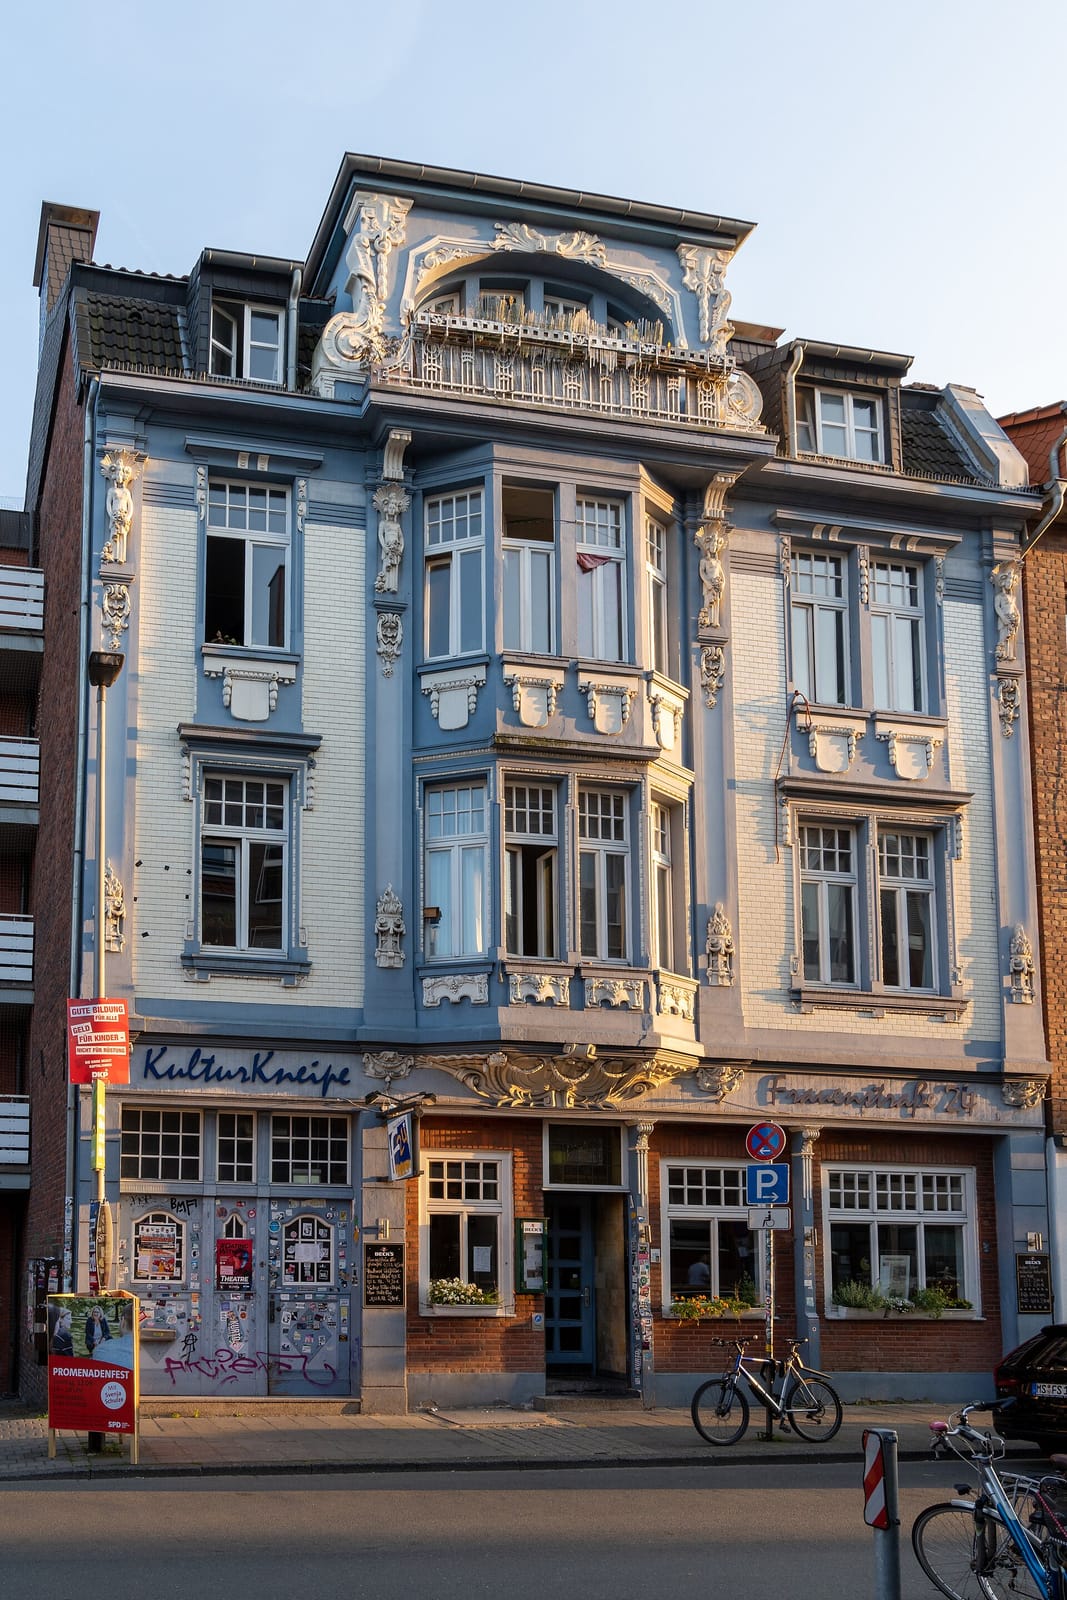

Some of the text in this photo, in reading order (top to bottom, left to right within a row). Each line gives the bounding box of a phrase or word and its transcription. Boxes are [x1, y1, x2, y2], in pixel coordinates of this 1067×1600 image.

[71, 1005, 124, 1016] GUTE BILDUNG
[72, 1025, 91, 1034] GELD
[79, 1034, 93, 1043] FÜR
[94, 1034, 119, 1042] KINDER
[91, 1070, 109, 1078] DKP
[143, 1046, 351, 1097] KulturKneipe
[944, 1083, 977, 1117] 24
[756, 1169, 779, 1199] P
[220, 1275, 249, 1283] THEATRE
[52, 1367, 130, 1380] PROMENADENFEST
[104, 1390, 122, 1398] Svenja
[1037, 1384, 1047, 1394] MS
[1051, 1385, 1063, 1395] FS
[108, 1421, 121, 1429] SPD
